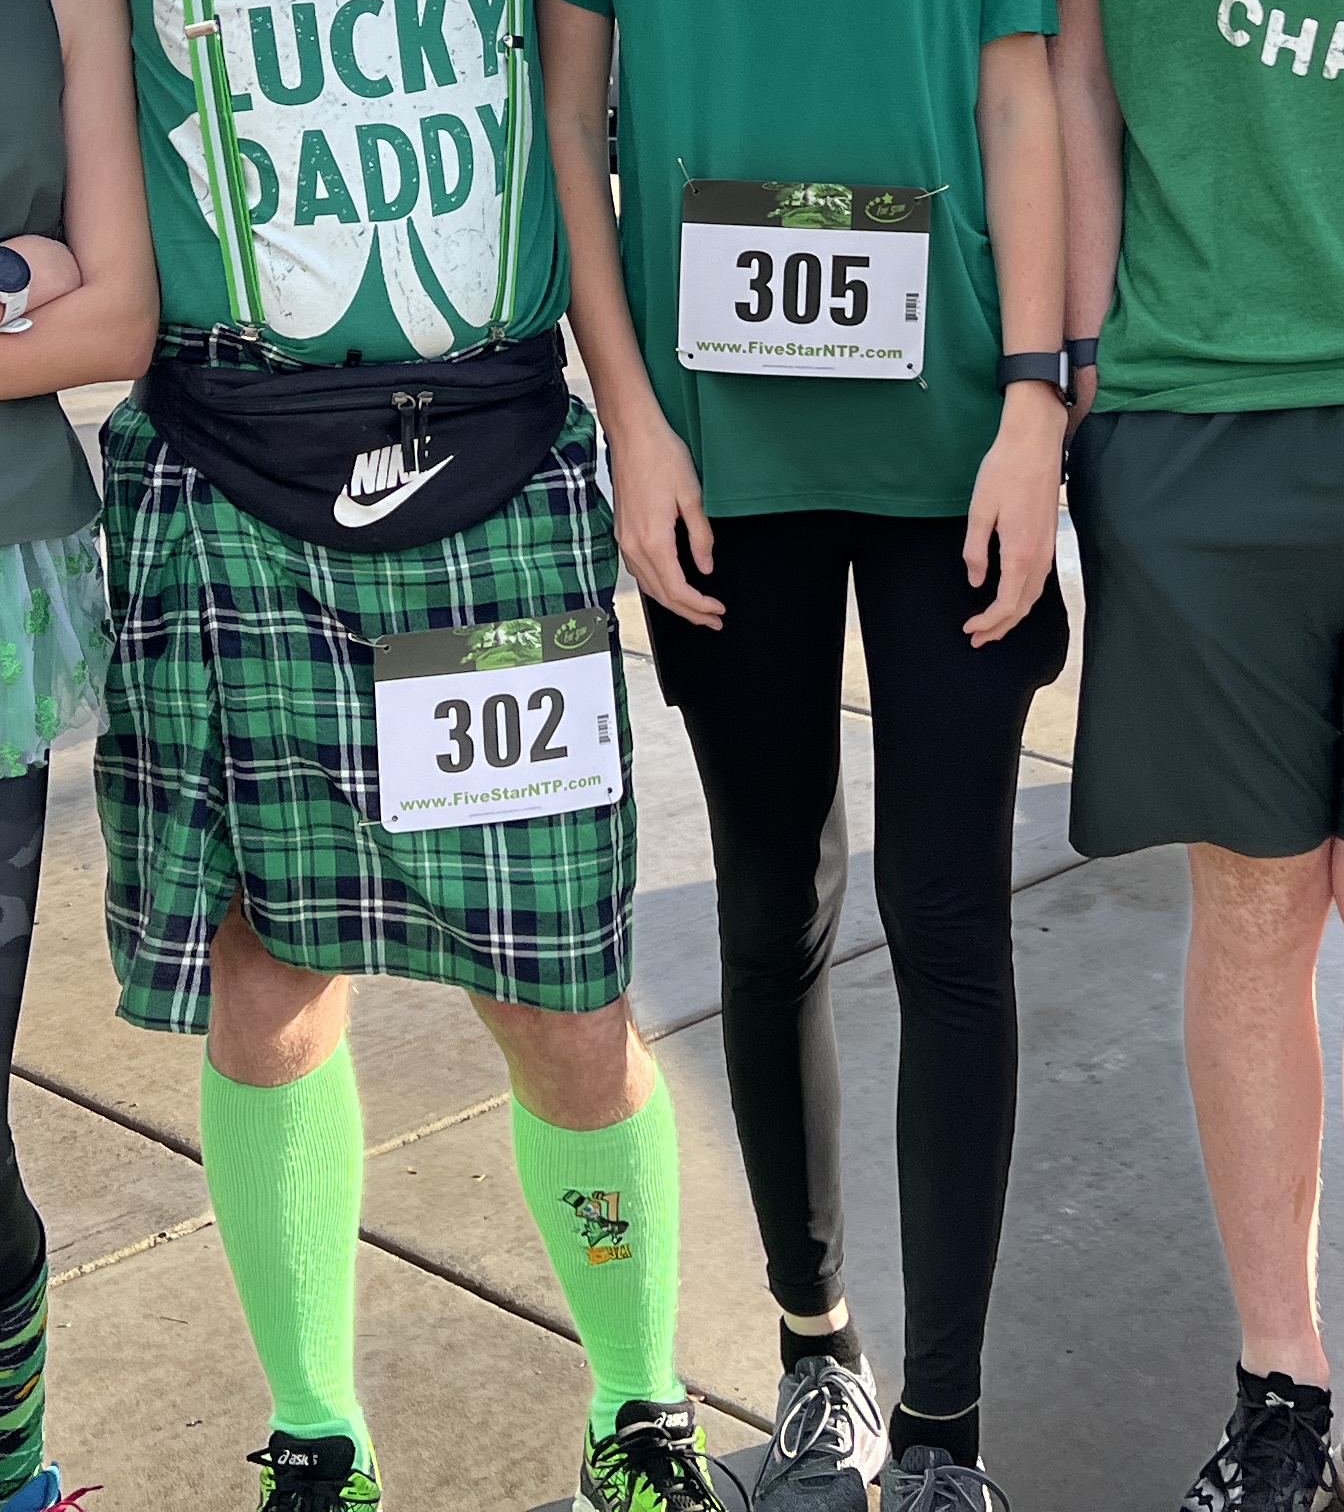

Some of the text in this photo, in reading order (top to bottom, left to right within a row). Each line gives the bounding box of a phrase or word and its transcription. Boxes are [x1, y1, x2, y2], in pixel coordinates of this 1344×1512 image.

[734, 250, 870, 326] 305
[695, 340, 903, 360] www.FiveStarNTP.com
[433, 687, 568, 773] 302
[399, 773, 603, 811] www.FiveStarNTP.com
